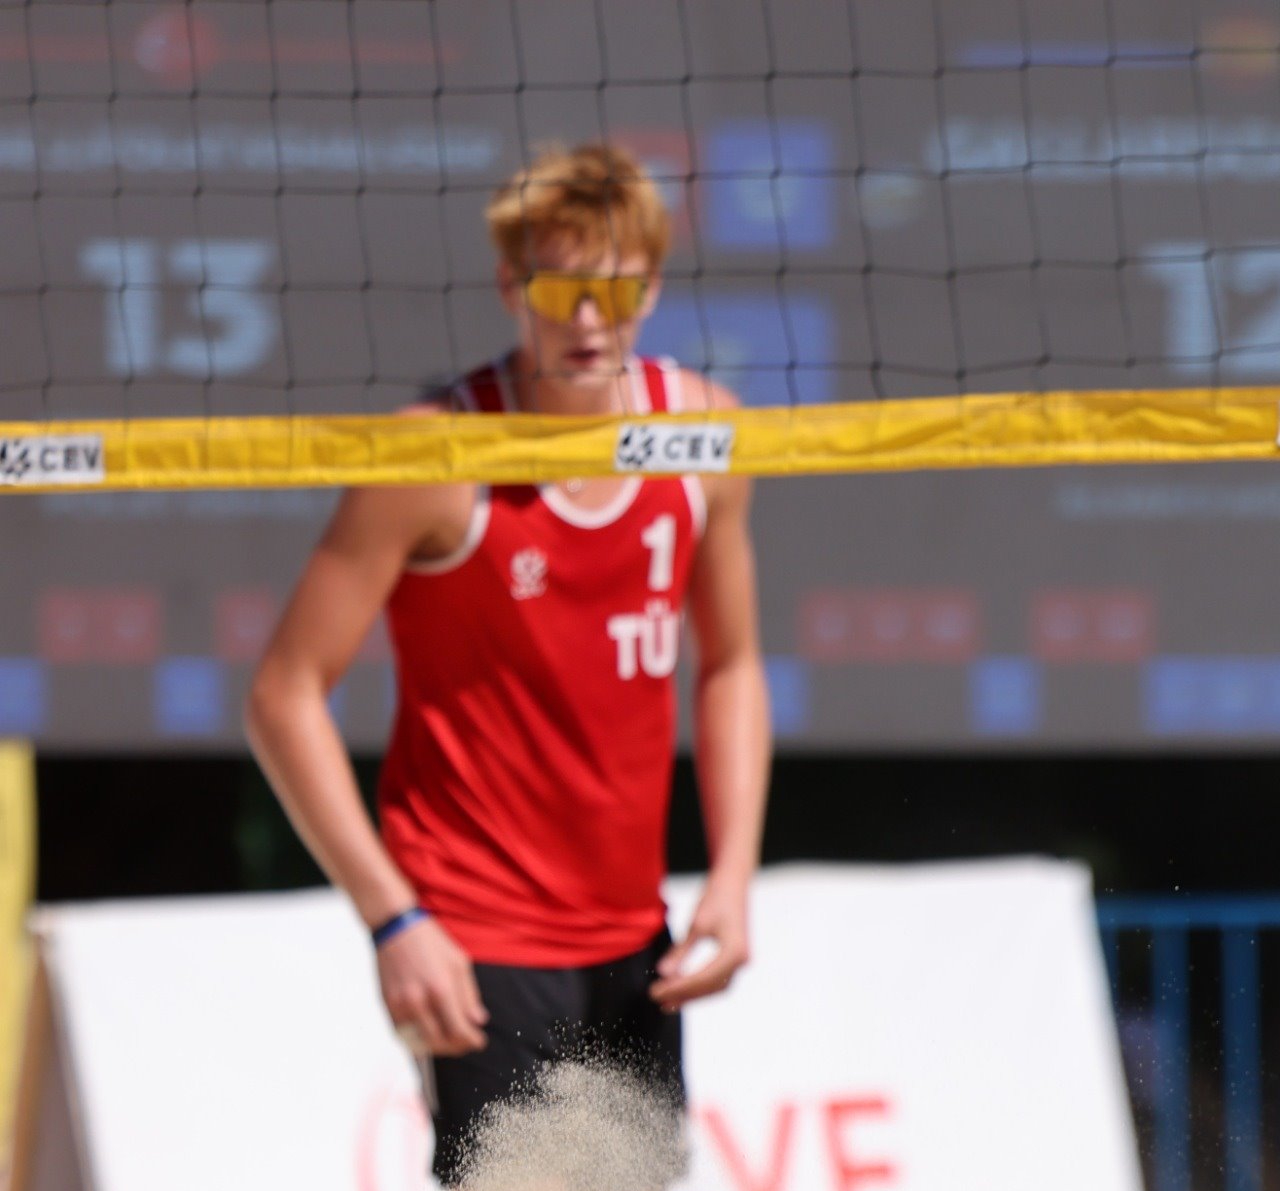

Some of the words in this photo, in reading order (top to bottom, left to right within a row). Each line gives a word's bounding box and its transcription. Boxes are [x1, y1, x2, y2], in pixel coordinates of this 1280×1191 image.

[82, 240, 278, 375] 13
[40, 446, 99, 471] CEV
[663, 433, 731, 460] CEV
[641, 514, 677, 592] 1
[606, 598, 682, 681] TÜ
